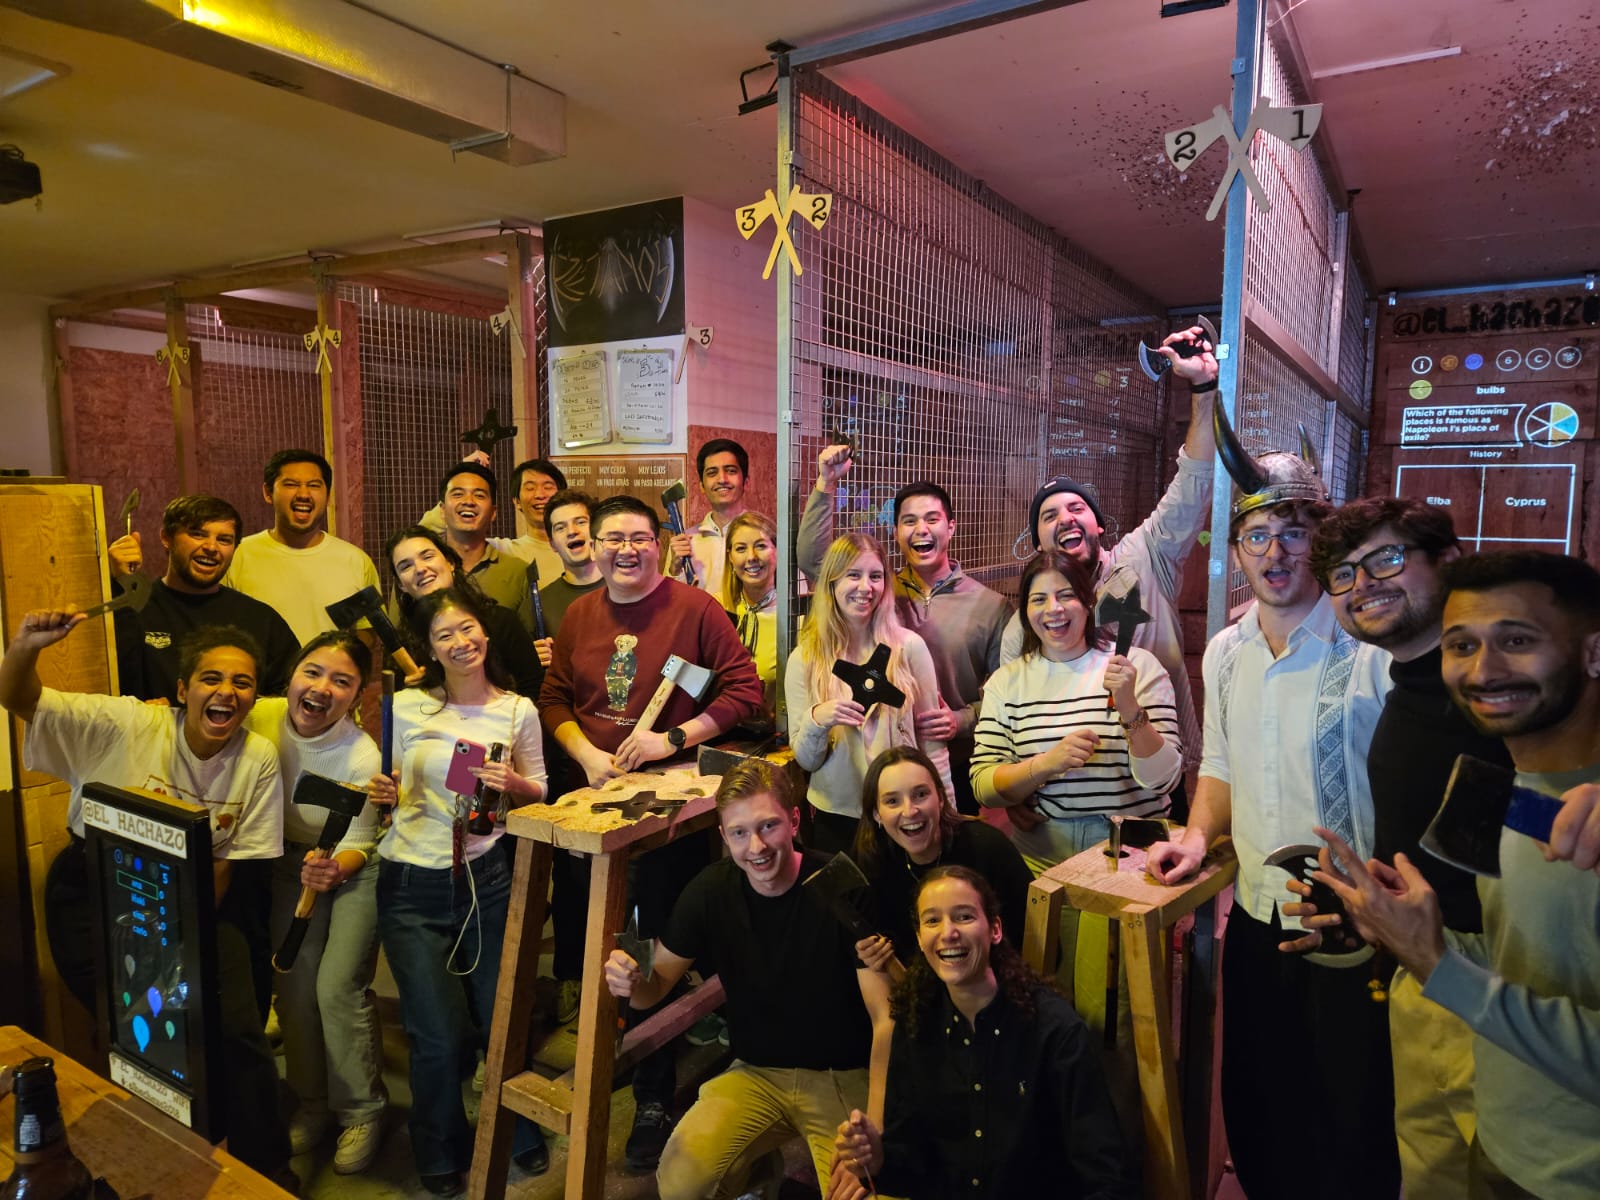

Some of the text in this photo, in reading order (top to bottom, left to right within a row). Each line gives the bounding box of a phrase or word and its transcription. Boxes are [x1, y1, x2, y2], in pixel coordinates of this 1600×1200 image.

[1173, 110, 1310, 162] 2 1
[741, 197, 827, 231] 3 2
[493, 316, 502, 330] 4
[333, 331, 340, 344] 4
[700, 328, 711, 345] 3
[1476, 386, 1506, 395] bulbs
[1466, 408, 1509, 416] following
[1405, 418, 1434, 426] places
[1405, 425, 1448, 434] Napoleon
[1462, 425, 1487, 433] place
[1469, 450, 1503, 458] History
[1426, 497, 1451, 506] Elba
[1505, 497, 1547, 507] Cyprus
[117, 812, 185, 851] HACHAZO
